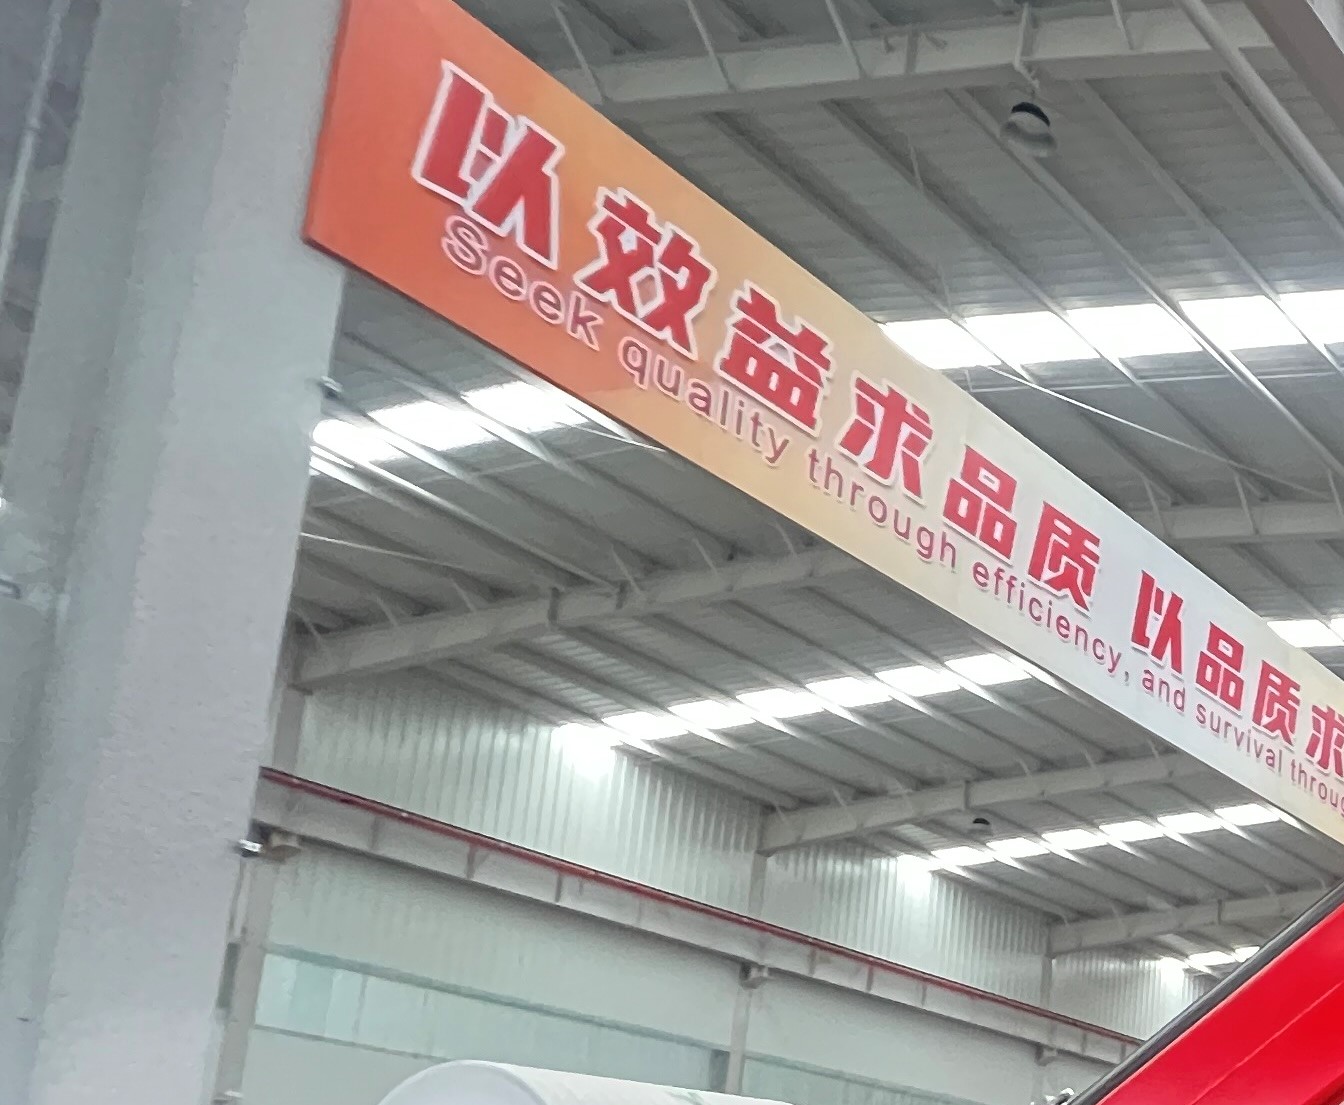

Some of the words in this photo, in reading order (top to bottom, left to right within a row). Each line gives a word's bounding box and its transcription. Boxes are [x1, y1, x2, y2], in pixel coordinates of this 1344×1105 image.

[412, 60, 1101, 612] 以效益求品质
[442, 215, 604, 351] Seek
[618, 336, 790, 470] quality
[807, 448, 958, 569] through
[1141, 670, 1187, 714] and
[1195, 700, 1284, 776] survival
